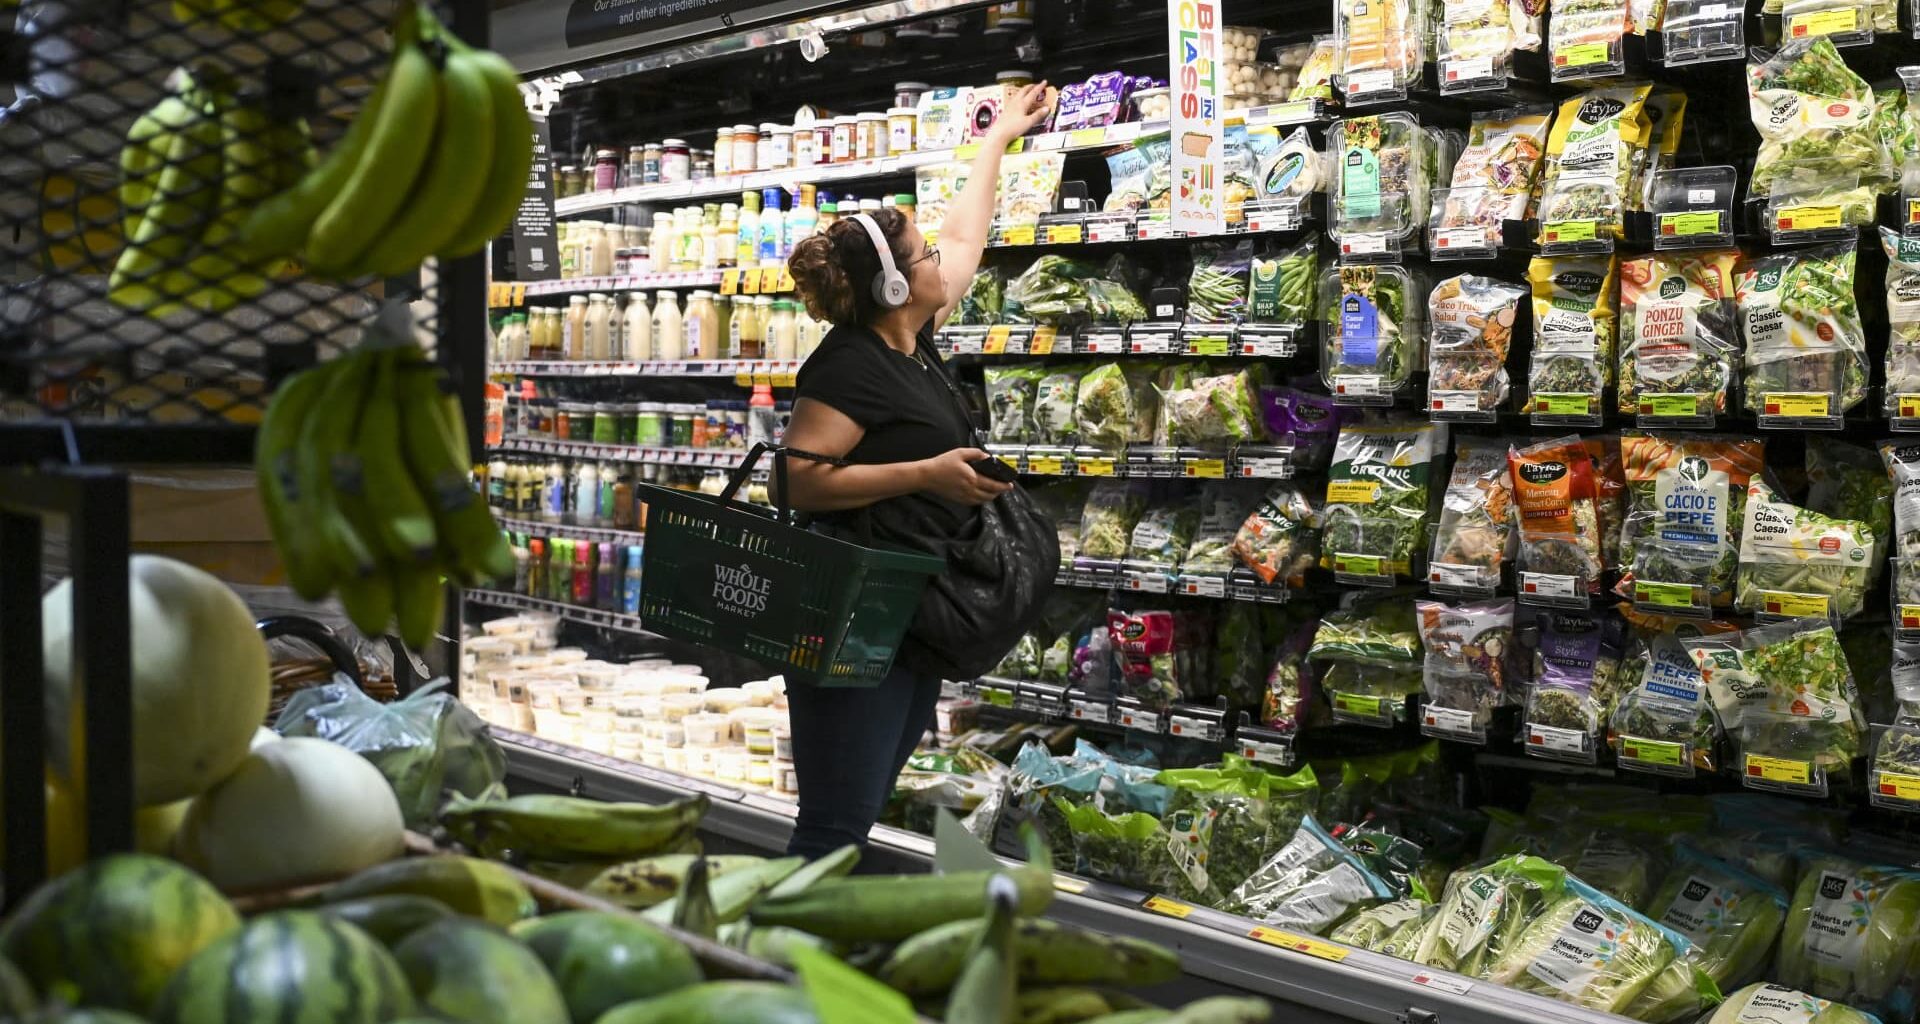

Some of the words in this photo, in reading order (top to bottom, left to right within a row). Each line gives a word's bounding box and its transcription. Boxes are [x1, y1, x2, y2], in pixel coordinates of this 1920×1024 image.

[618, 12, 634, 24] and
[635, 7, 657, 20] other
[1197, 2, 1216, 96] BEST
[1179, 1, 1198, 120] CLASS
[1203, 98, 1212, 118] IN
[1583, 102, 1622, 115] Taylor
[1758, 270, 1779, 286] 365
[1435, 311, 1457, 322] Salad
[1645, 307, 1683, 323] PONZU
[1749, 309, 1783, 324] Classic
[1642, 322, 1684, 338] GINGER
[1750, 321, 1783, 335] Caesar
[1524, 462, 1566, 473] Taylor
[1545, 497, 1566, 507] Corn
[1665, 494, 1705, 510] CACIO
[1707, 496, 1717, 510] E
[1665, 511, 1716, 526] PEPE
[1663, 532, 1694, 541] PREMIUM
[714, 563, 772, 596] WHOLE
[712, 580, 768, 612] FOODS
[716, 601, 757, 619] MARKET
[1653, 662, 1701, 682] PEPE
[1647, 684, 1675, 695] PREMIUM
[1823, 878, 1845, 893] 365
[1578, 914, 1599, 929] 365
[1669, 907, 1693, 921] Hearts
[1693, 918, 1704, 926] of
[1812, 910, 1841, 925] Hearts
[1842, 919, 1853, 928] of
[1811, 920, 1847, 937] Romaine
[1556, 936, 1583, 955] Hearts
[1550, 944, 1583, 964] Romaine
[1751, 1000, 1791, 1012] Romaine
[1755, 994, 1787, 1004] Hearts
